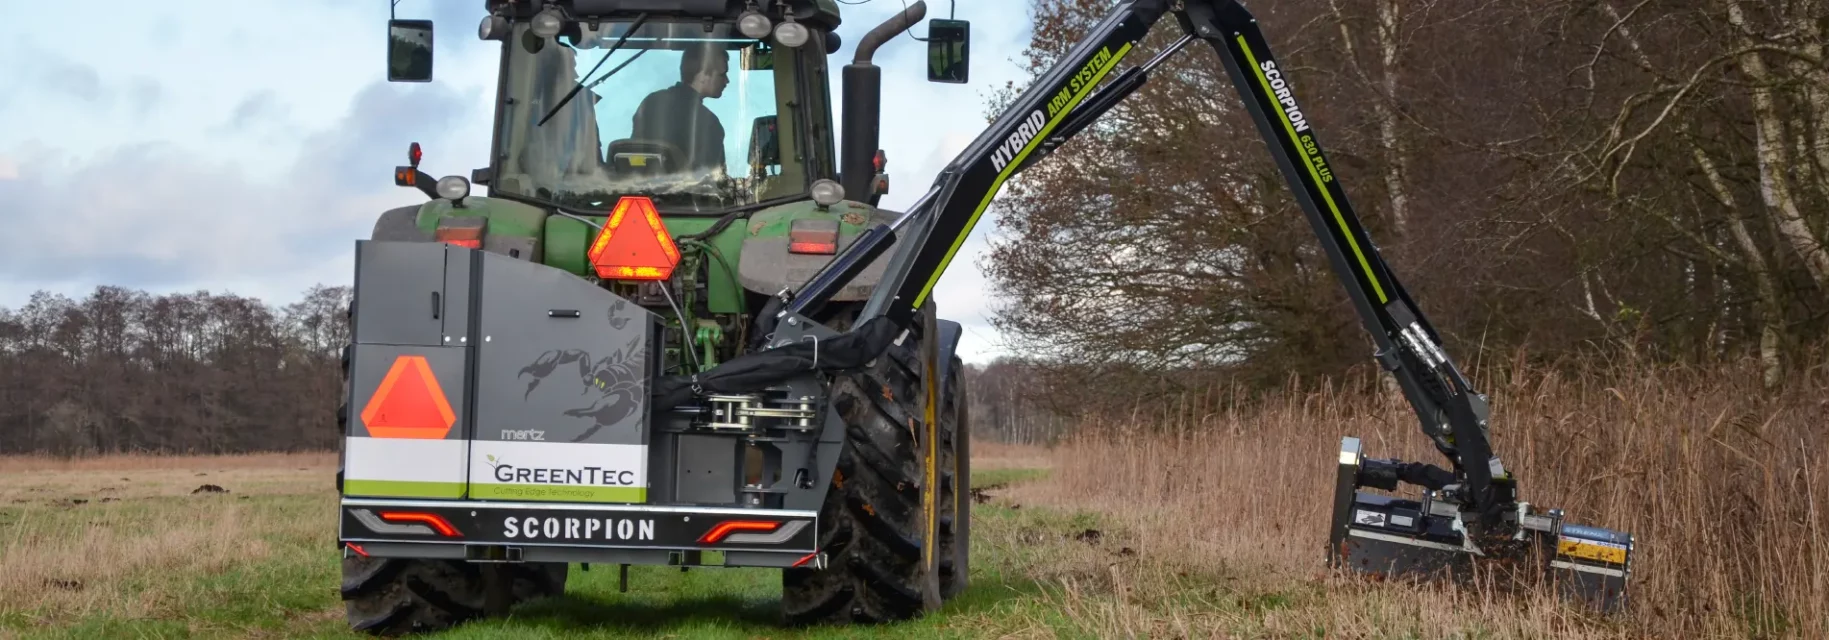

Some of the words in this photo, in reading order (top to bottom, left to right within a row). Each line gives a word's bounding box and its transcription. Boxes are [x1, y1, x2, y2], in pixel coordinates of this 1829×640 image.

[990, 109, 1046, 173] HYBRID
[1047, 86, 1072, 118] ARM
[1070, 45, 1112, 93] SYSTEM
[1260, 60, 1309, 133] SCORPION
[1300, 135, 1318, 155] 630
[1312, 155, 1333, 183] PLUS
[493, 486, 523, 497] Cutting
[525, 487, 546, 497] Edge
[547, 487, 595, 498] Technology
[503, 516, 655, 540] SCORPION
